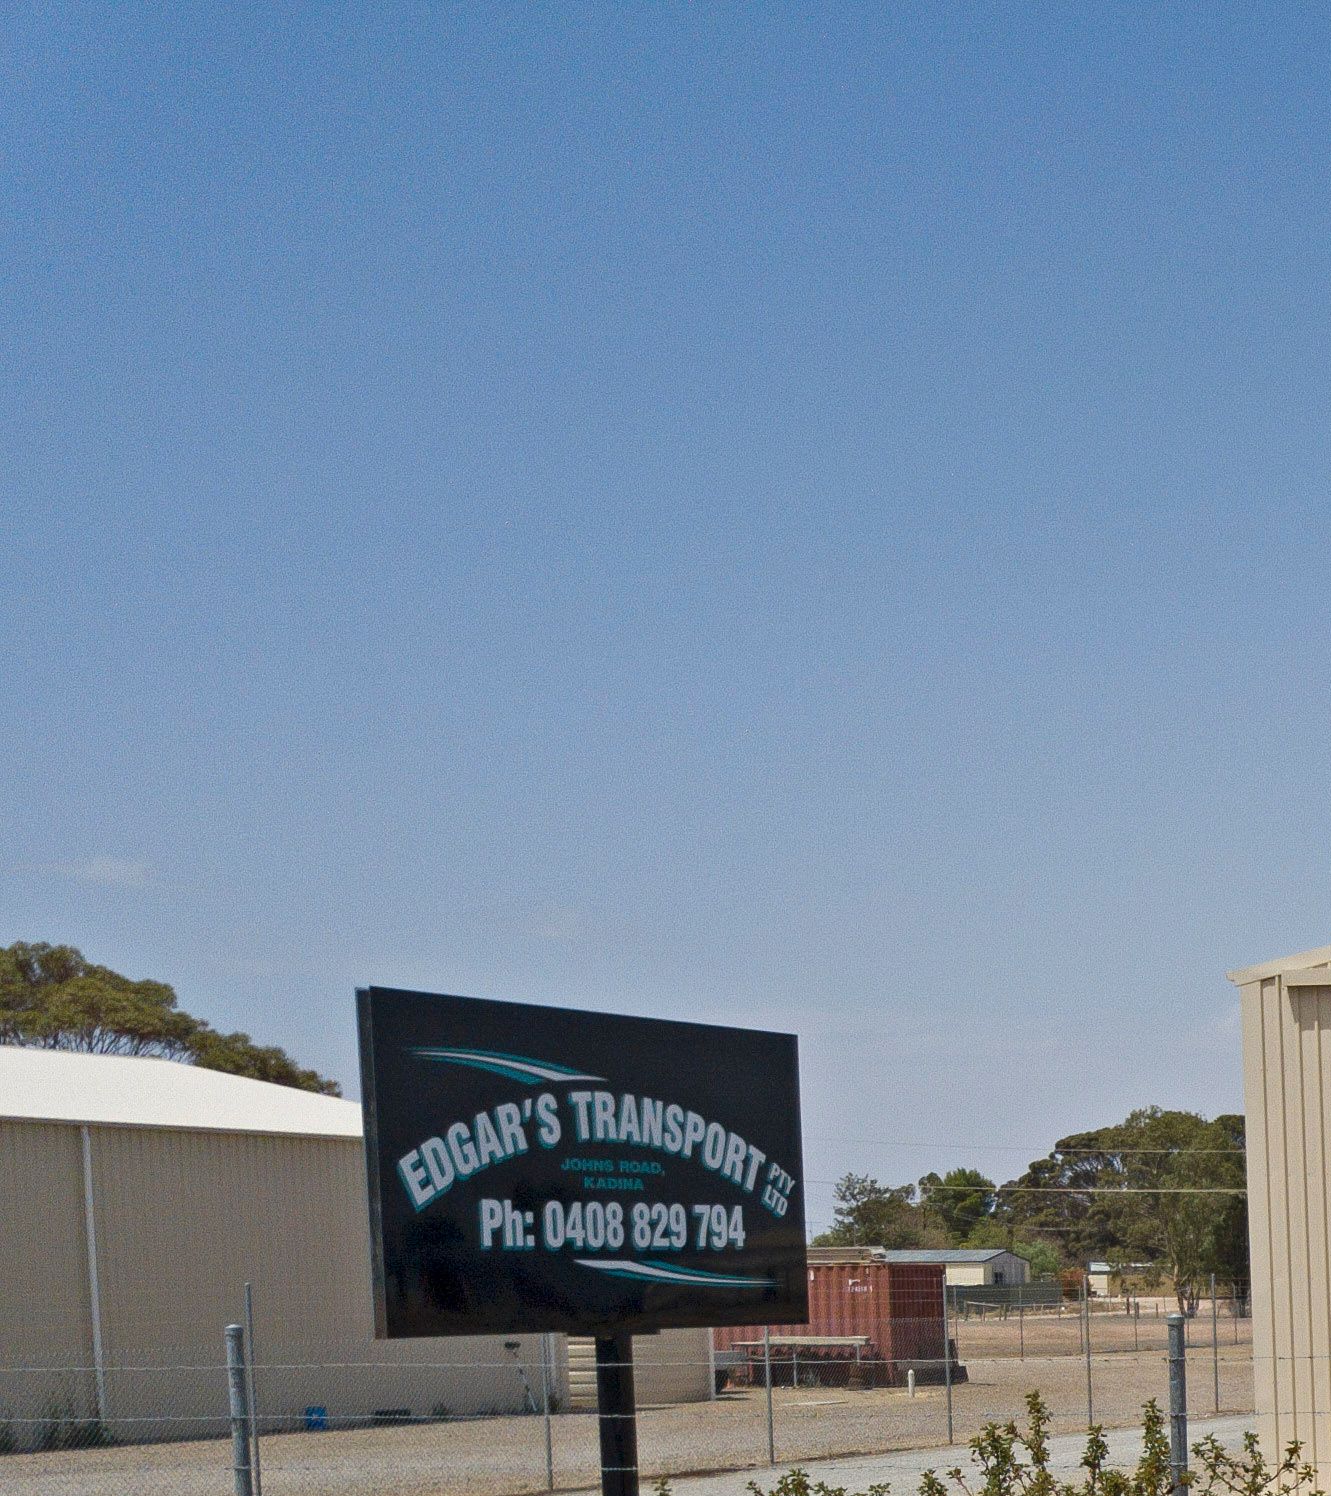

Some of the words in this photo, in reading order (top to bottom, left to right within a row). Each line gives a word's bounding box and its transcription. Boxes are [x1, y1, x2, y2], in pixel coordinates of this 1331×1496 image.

[398, 1092, 562, 1209] EDGAR'S
[569, 1091, 766, 1193] TRANSPORT
[583, 1177, 644, 1190] KADINA
[767, 1162, 796, 1196] PTY
[761, 1185, 789, 1217] LTD
[480, 1198, 535, 1249] Ph:
[544, 1200, 625, 1249] 0408
[631, 1202, 687, 1249] 829
[694, 1203, 746, 1249] 794
